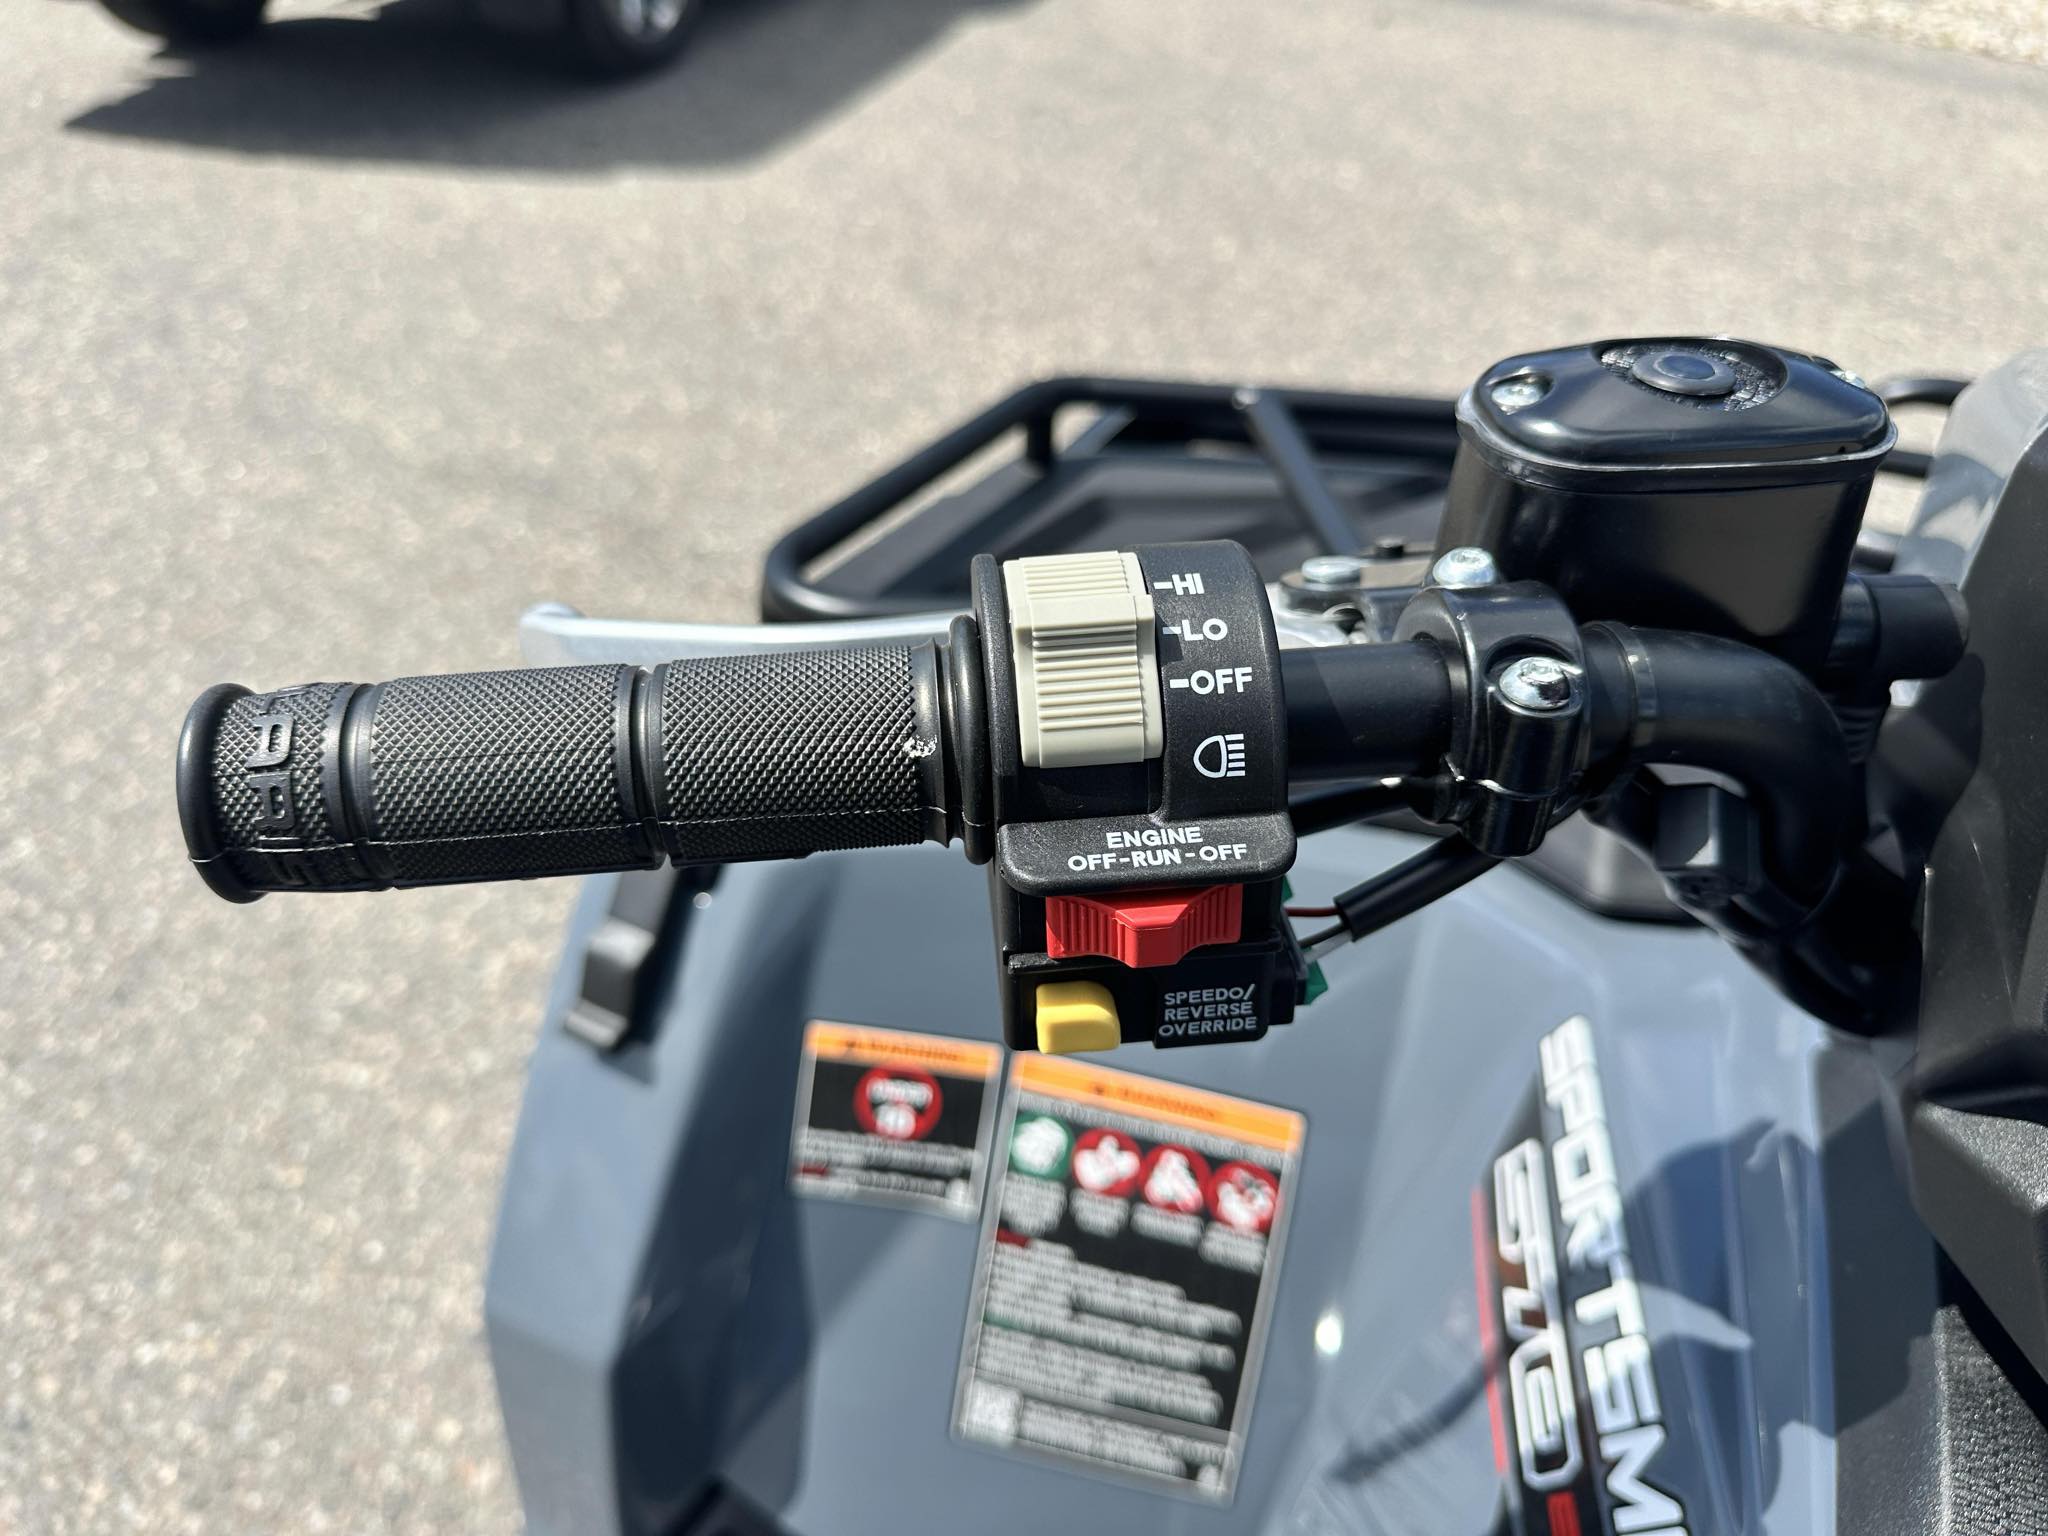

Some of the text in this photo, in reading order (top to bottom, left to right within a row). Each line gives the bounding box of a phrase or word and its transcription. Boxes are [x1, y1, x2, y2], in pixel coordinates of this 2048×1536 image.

[1171, 573, 1205, 595] HI
[1182, 618, 1228, 641] LO
[1190, 667, 1252, 694] OFF
[1105, 826, 1203, 849] ENGINE
[1163, 983, 1256, 1005] SPEEDO/
[1164, 1001, 1254, 1021] REVERSE
[1158, 1016, 1257, 1036] OVERRIDE
[1539, 1013, 1688, 1536] SPORTSM
